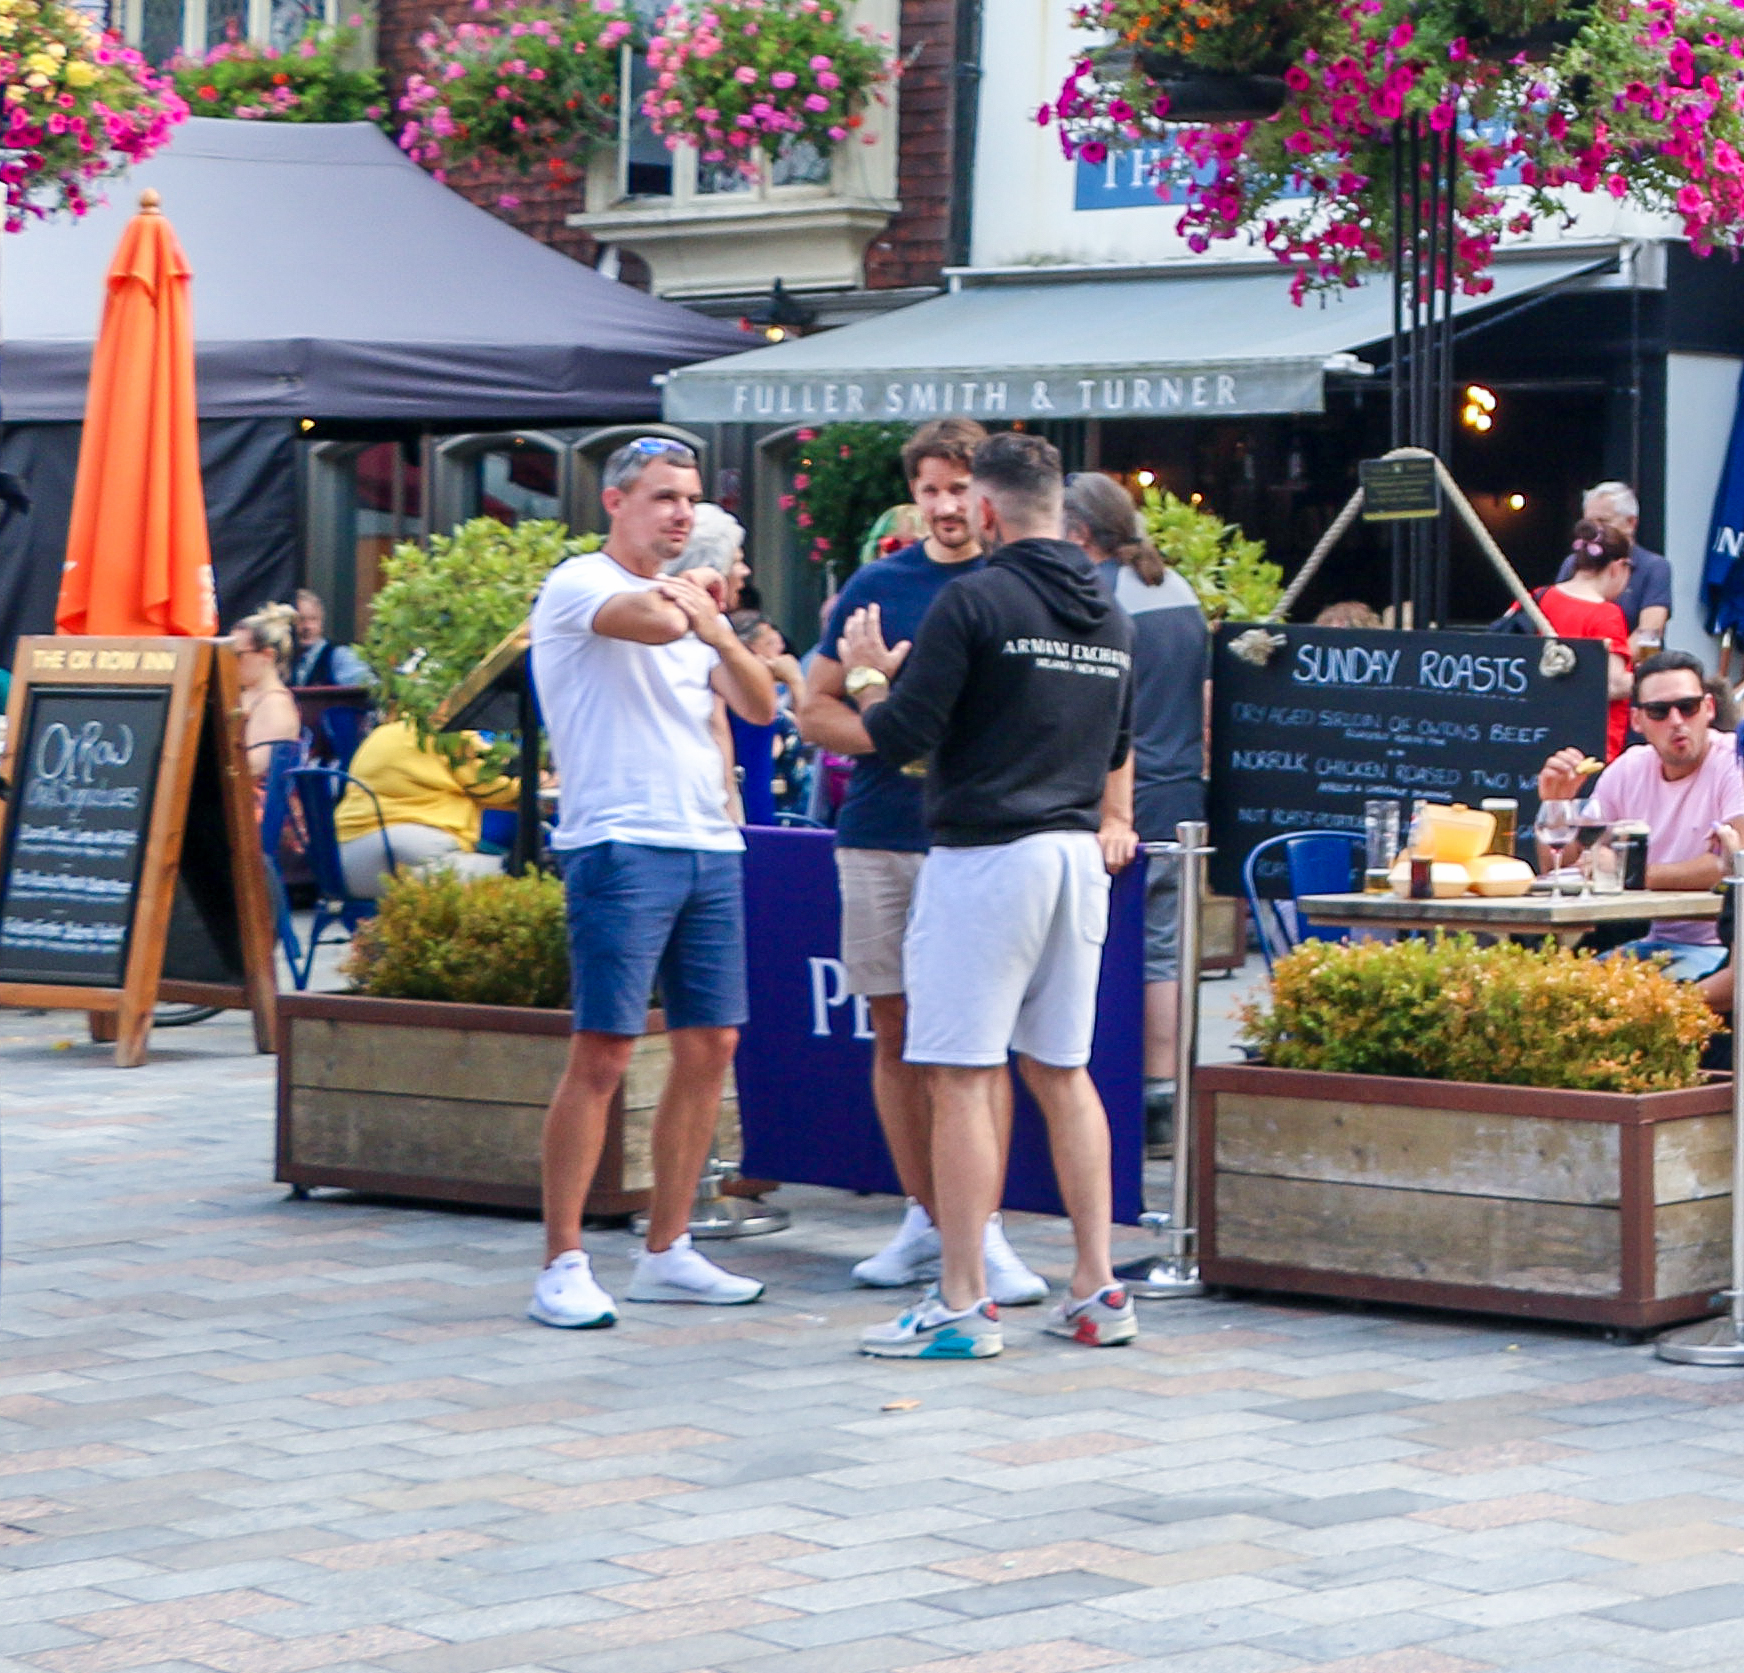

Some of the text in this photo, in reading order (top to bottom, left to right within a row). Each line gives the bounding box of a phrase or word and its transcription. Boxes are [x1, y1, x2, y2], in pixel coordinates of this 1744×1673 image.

[733, 374, 1238, 416] FULLER SMITH & TURNER
[33, 649, 178, 672] THE OX ROW INN
[1293, 644, 1528, 693] SUNDAY ROASTS
[1489, 723, 1552, 744] BEEF
[1231, 750, 1310, 773] NORFOLK
